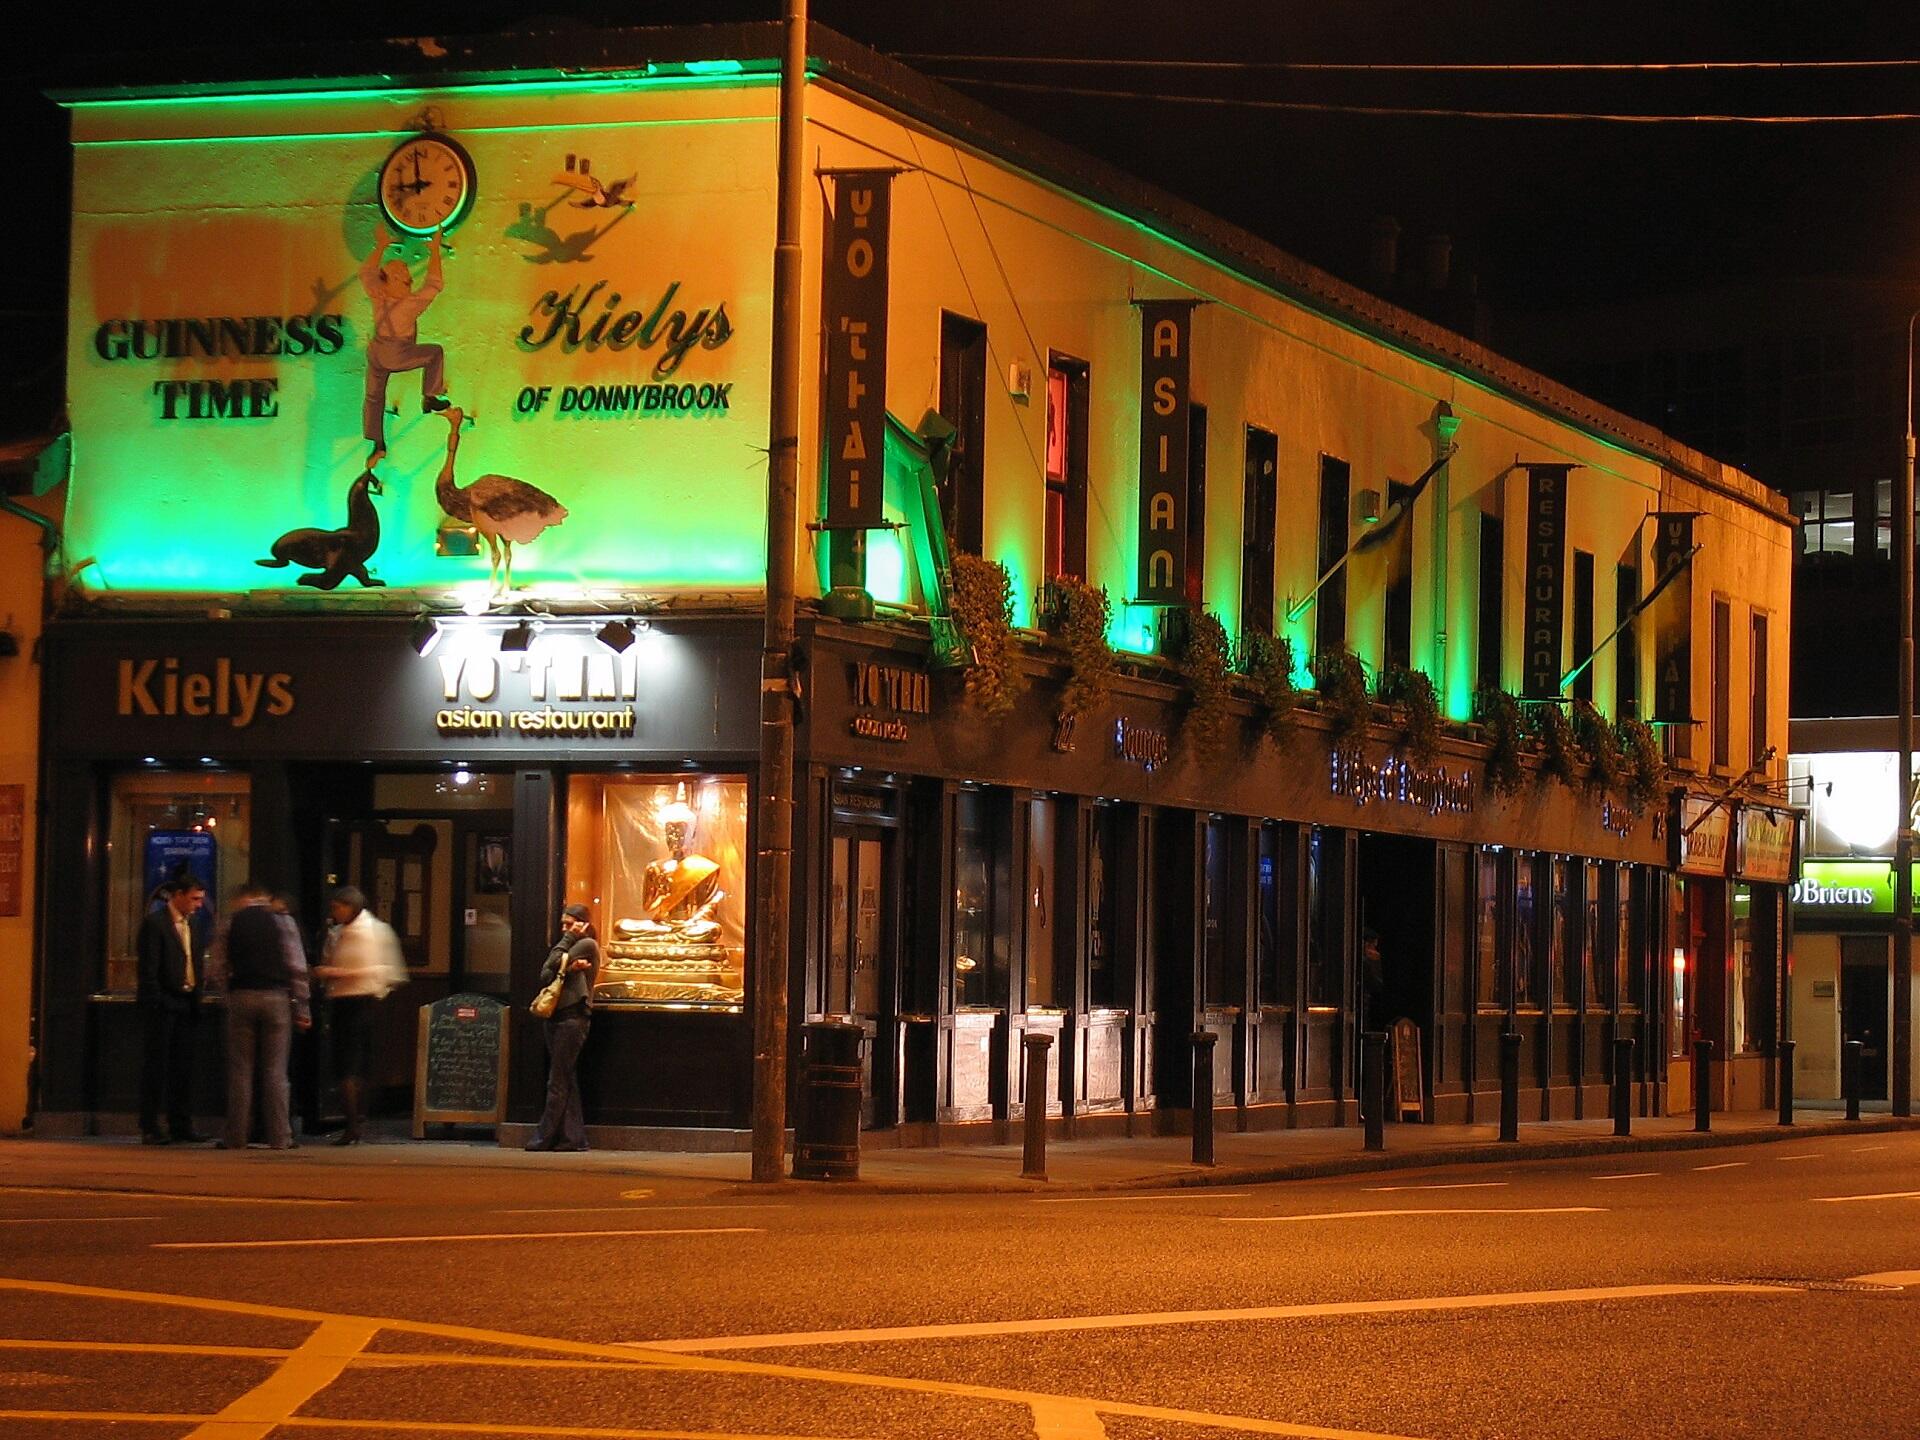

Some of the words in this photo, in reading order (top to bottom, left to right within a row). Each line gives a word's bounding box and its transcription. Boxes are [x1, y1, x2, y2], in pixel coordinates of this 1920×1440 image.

[95, 314, 345, 361] GUINNESS
[519, 279, 735, 376] Kielys
[153, 377, 278, 419] TIME
[517, 386, 552, 413] OF
[560, 382, 733, 412] DONNYBROOK
[1534, 478, 1554, 688] RESTAURANT
[118, 657, 295, 727] Kielys
[436, 706, 502, 728] asian
[509, 705, 633, 729] restaurant
